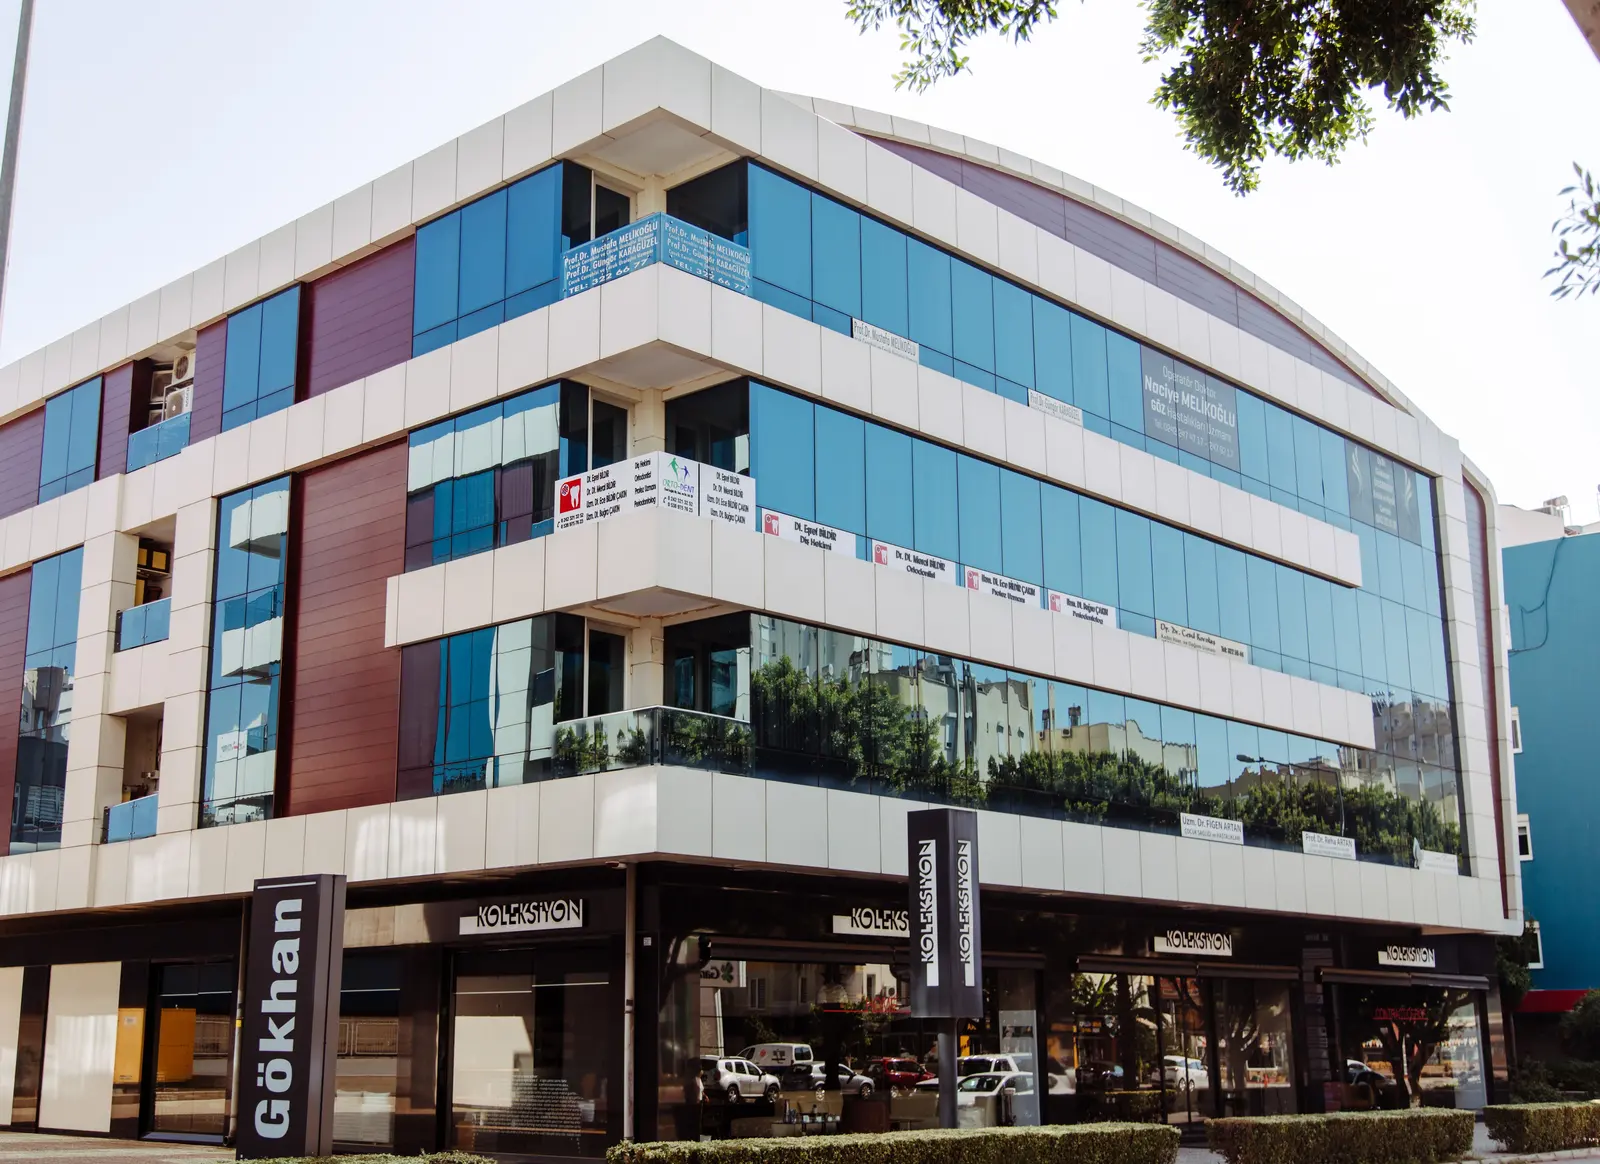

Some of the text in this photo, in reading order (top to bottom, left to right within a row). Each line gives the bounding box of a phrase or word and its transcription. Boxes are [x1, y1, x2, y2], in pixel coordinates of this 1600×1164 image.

[591, 238, 617, 256] Mustafa
[619, 236, 658, 259] KARAGÜZEL
[569, 258, 648, 294] TEL: 322 66 77
[674, 259, 692, 272] TEL:
[696, 268, 715, 280] 322
[718, 277, 731, 286] 66
[734, 283, 746, 291] 77
[717, 258, 751, 279] KARAGÜZEL
[1162, 366, 1216, 399] Operatör Doktor
[1145, 375, 1235, 427] Naciye MELİKOĞLU
[1151, 398, 1166, 415] GÖZ
[663, 479, 694, 493] ORTO-DENT
[810, 538, 832, 551] Hekimi
[895, 549, 904, 560] Dr.
[1171, 626, 1181, 636] Dr.
[1197, 818, 1206, 827] Dr.
[1223, 822, 1241, 832] ARTAN
[1337, 838, 1353, 848] ARTAN
[851, 907, 909, 932] KOLEKS
[255, 899, 302, 1139] Gökhan
